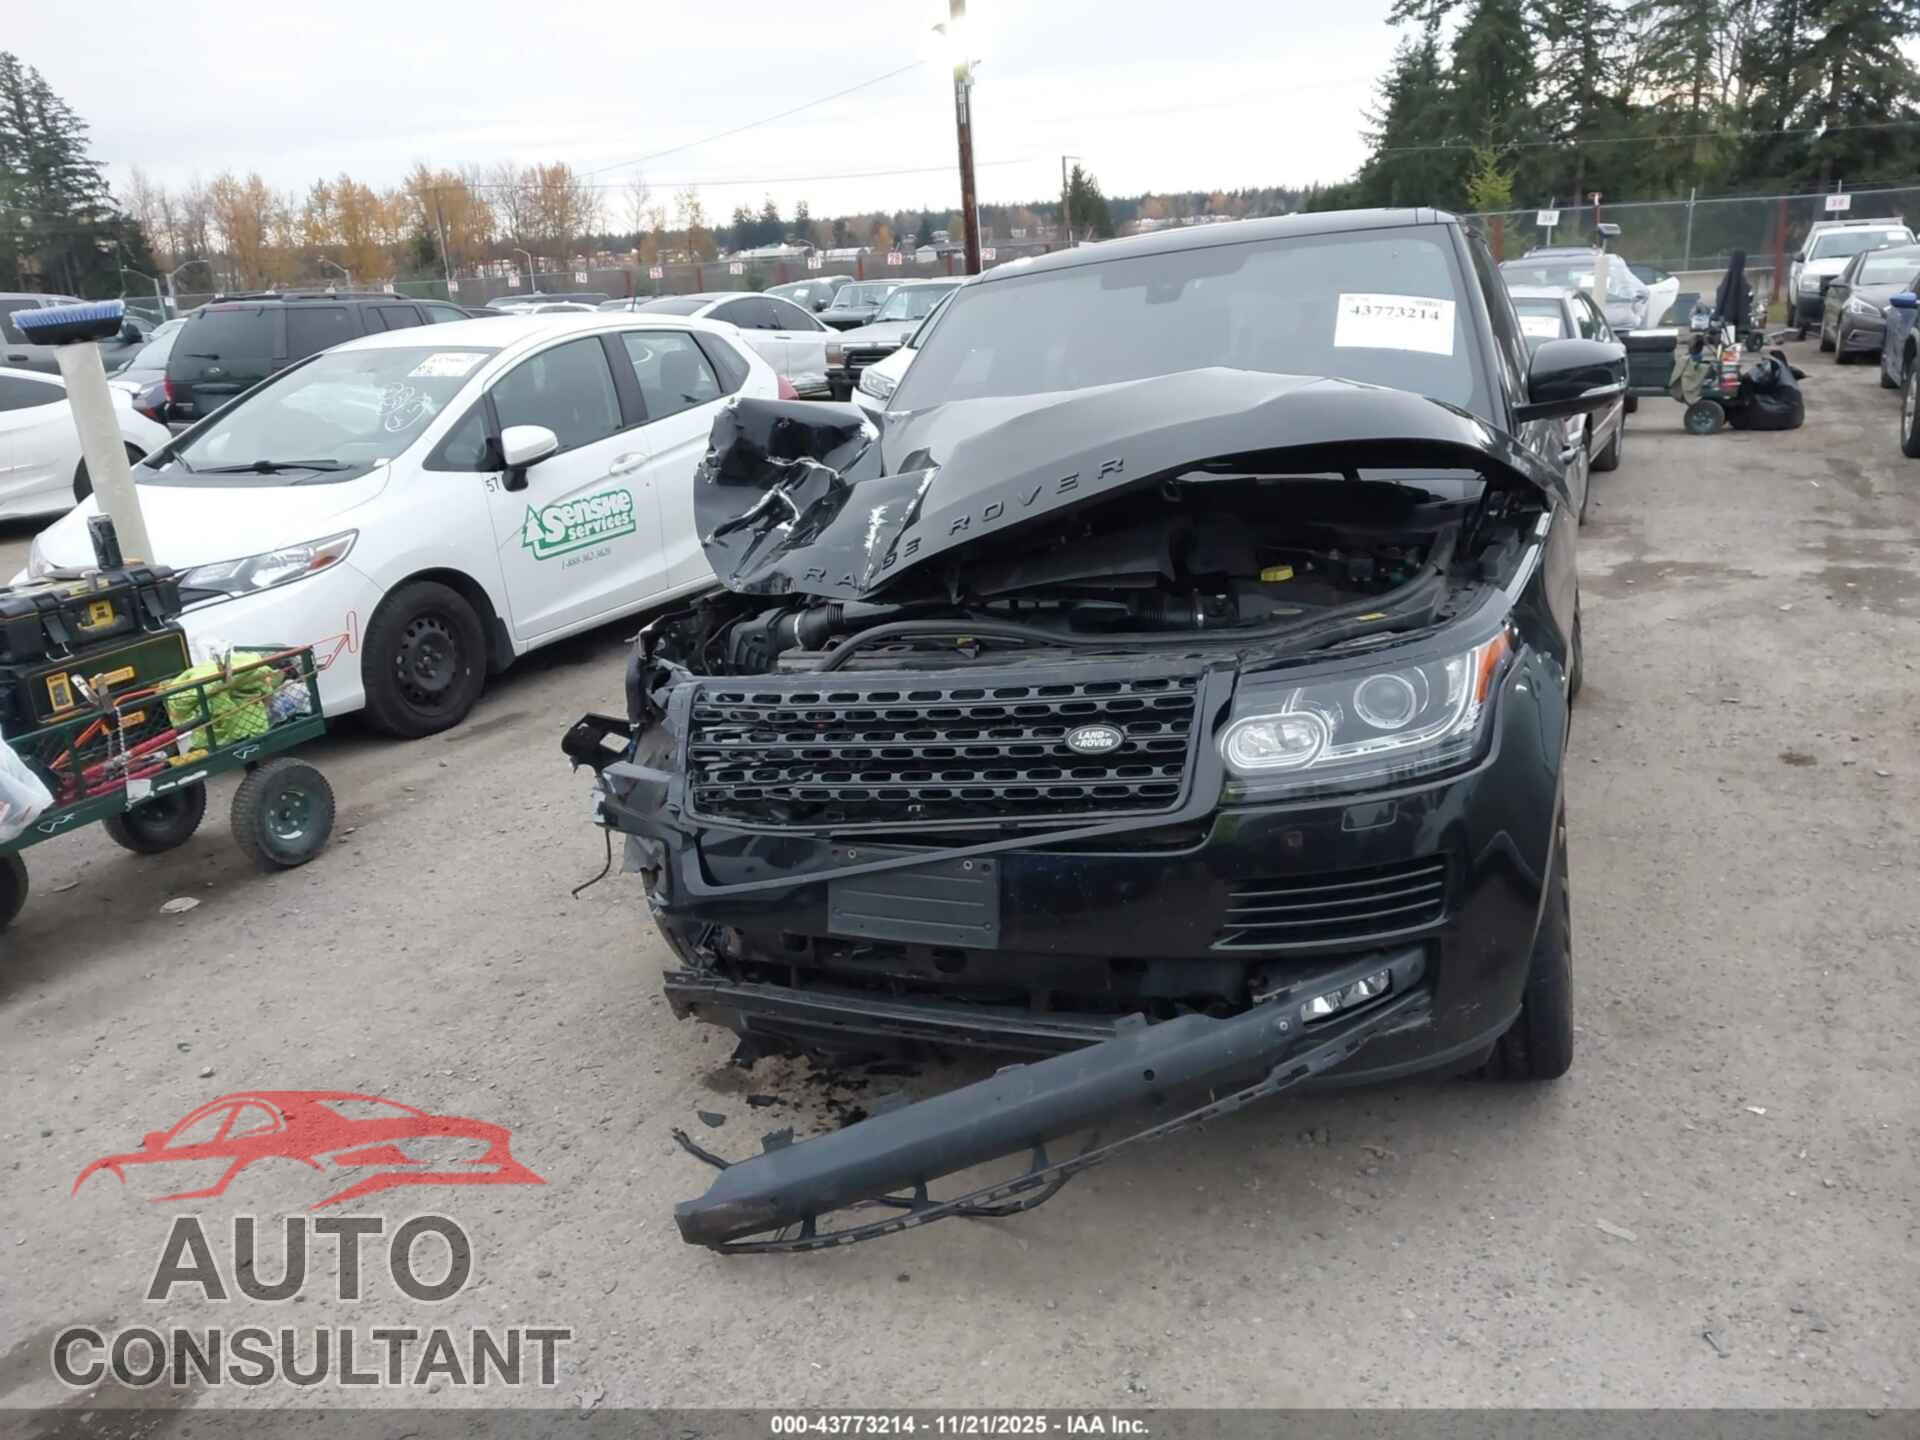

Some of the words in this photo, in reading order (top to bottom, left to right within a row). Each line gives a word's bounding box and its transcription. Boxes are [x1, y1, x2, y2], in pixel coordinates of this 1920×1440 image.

[1349, 305, 1440, 320] 43773214
[803, 536, 922, 590] RAGE
[949, 457, 1124, 535] ROVER
